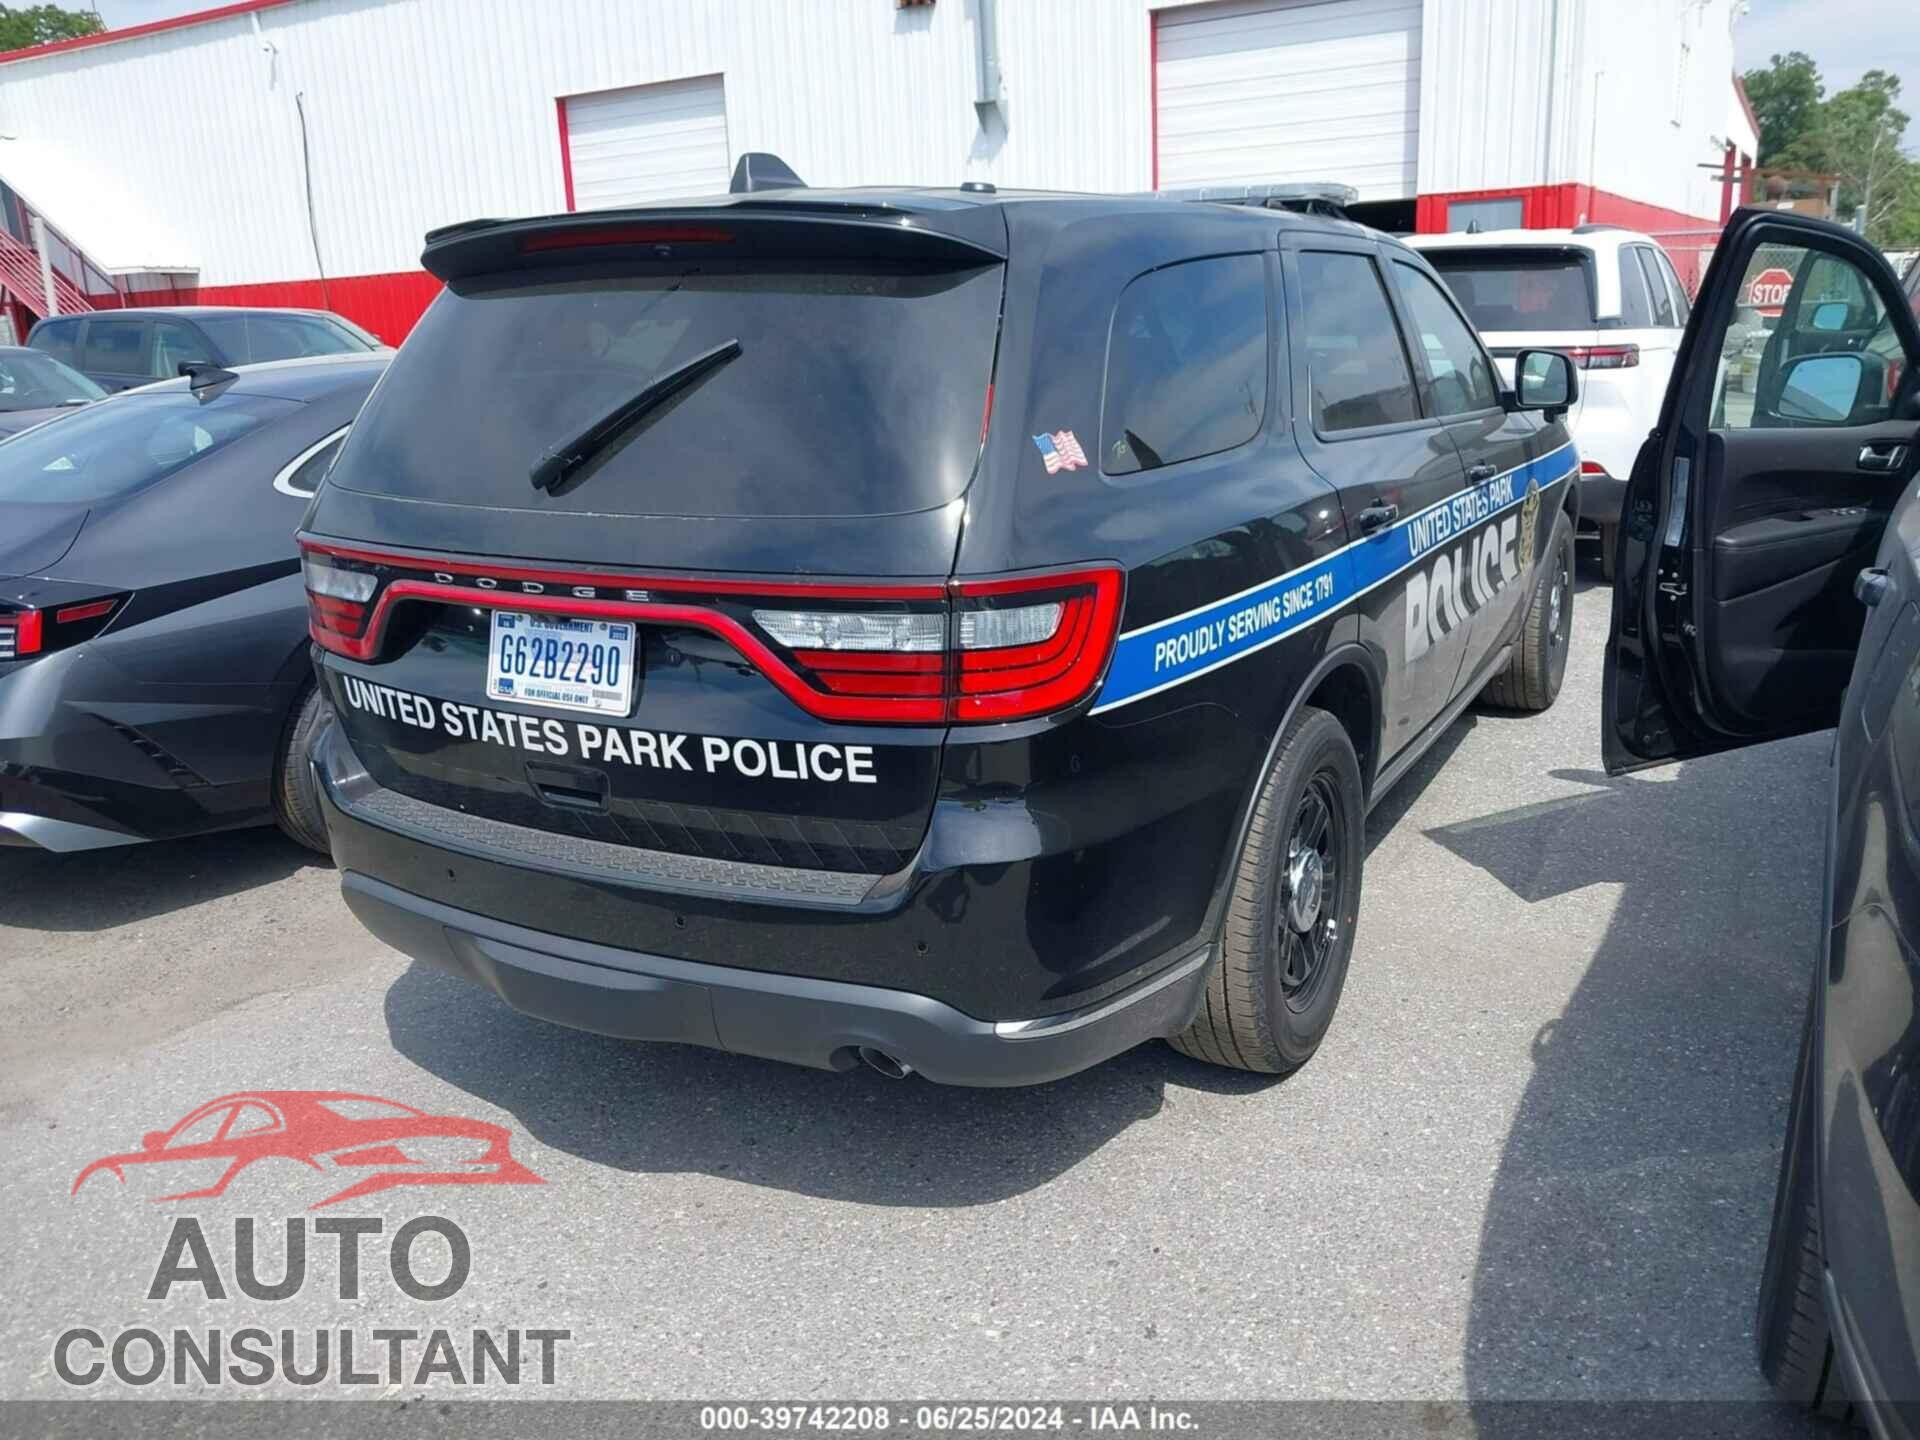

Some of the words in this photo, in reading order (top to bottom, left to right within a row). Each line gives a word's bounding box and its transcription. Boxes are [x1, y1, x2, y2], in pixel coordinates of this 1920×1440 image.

[1407, 504, 1452, 557] UNITED
[1452, 484, 1489, 532] STATES
[1489, 475, 1515, 512] PARK
[434, 572, 649, 602] DODGE
[1154, 619, 1227, 673] PROUDLY
[1227, 596, 1282, 643] SERVING
[1282, 581, 1314, 618] SINCE
[1314, 571, 1334, 602] 1791
[1405, 513, 1519, 665] POLICE
[500, 634, 621, 687] G62B2290
[524, 687, 536, 697] FOR
[536, 689, 561, 701] OFFICIAL
[562, 692, 574, 703] USE
[344, 674, 436, 729] UNITED
[444, 706, 569, 756] STATES
[577, 725, 693, 772] PARK
[702, 736, 878, 783] POLICE
